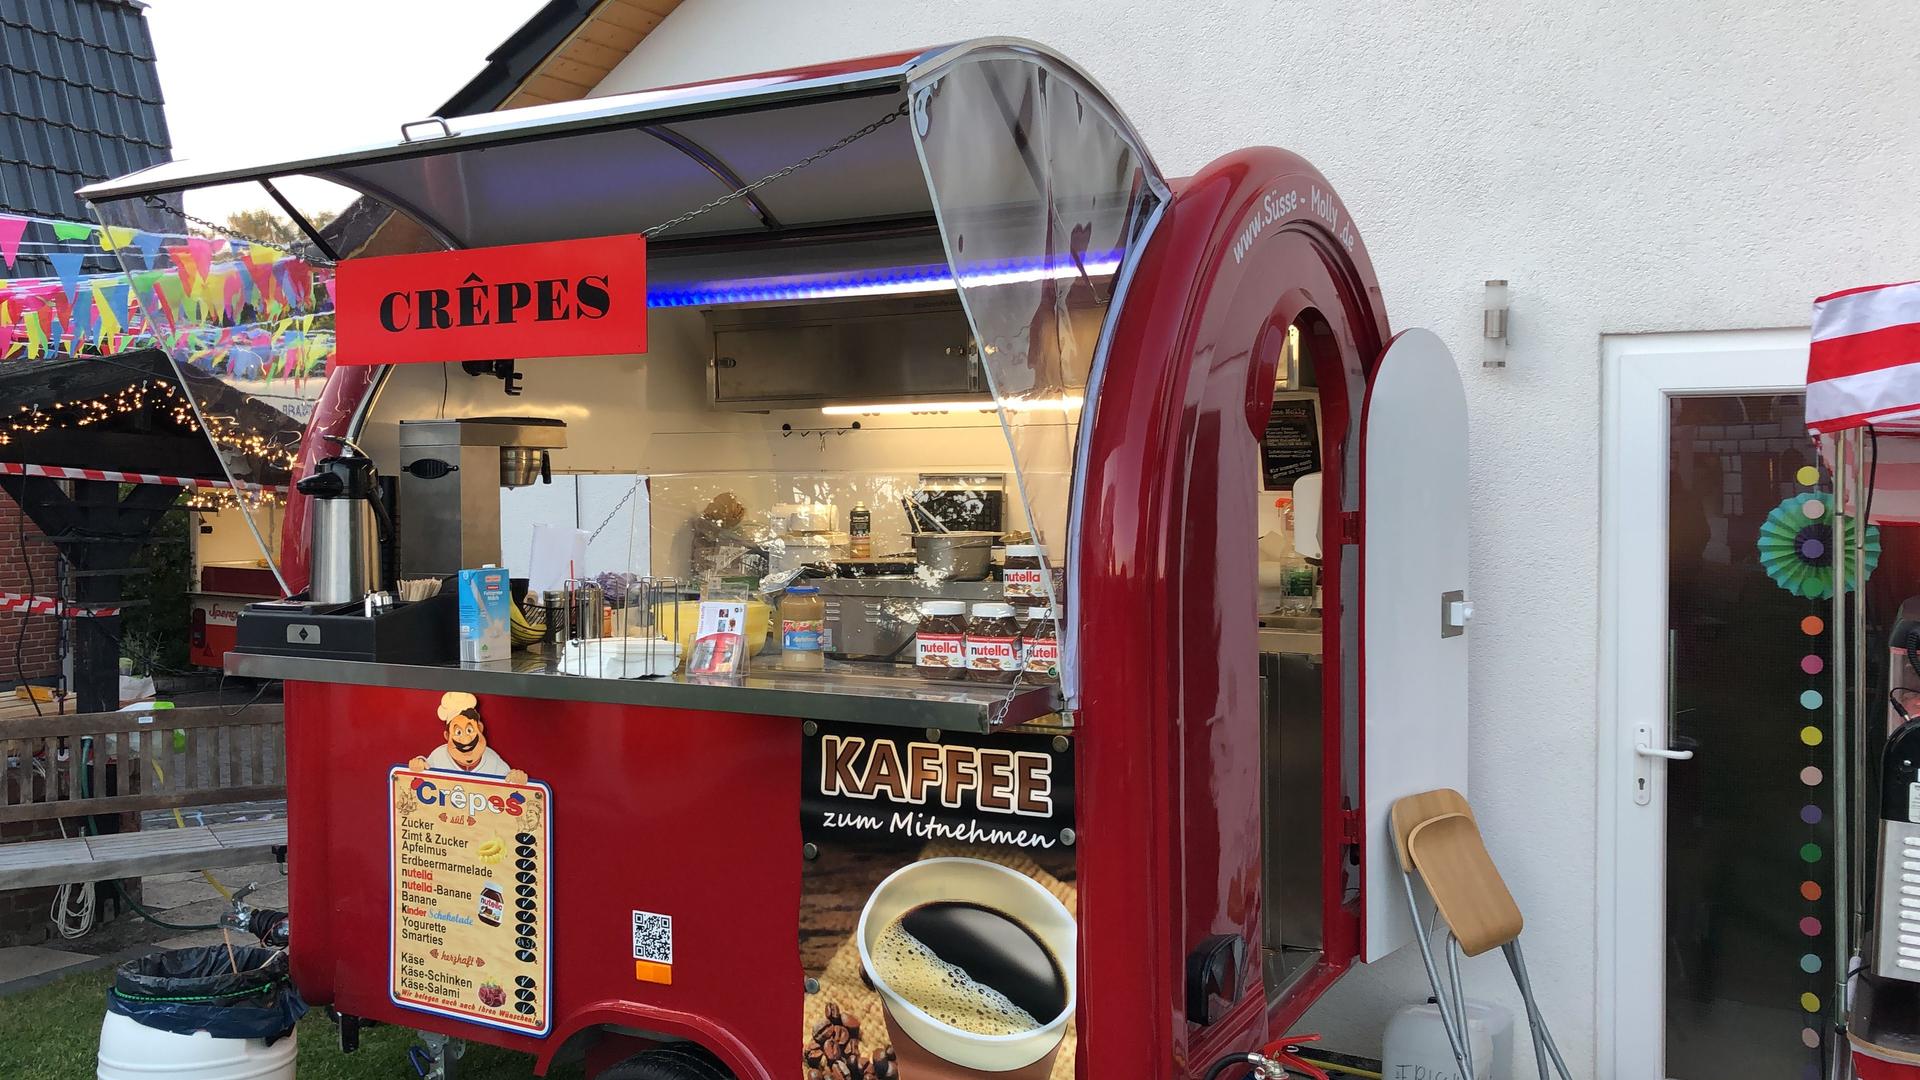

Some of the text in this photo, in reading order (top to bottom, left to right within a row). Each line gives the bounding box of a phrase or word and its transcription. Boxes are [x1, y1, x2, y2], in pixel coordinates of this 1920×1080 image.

[1233, 190, 1297, 264] www.Süsse
[1311, 185, 1338, 232] Molly
[1340, 221, 1354, 252] .de
[379, 272, 611, 332] CRÊPES
[1005, 571, 1041, 583] nutella
[920, 642, 958, 654] nutella
[971, 645, 1010, 657] nutella
[821, 735, 1053, 818] KAFFEE
[416, 781, 523, 816] Crêpes
[401, 816, 434, 831] Zucker
[823, 810, 1056, 849] zum Mitnehmen
[401, 829, 469, 849] Zimt & Zucker
[401, 841, 447, 857] Apfelmus
[401, 854, 493, 878] Erdbeermarmelade
[401, 868, 433, 881] nutella
[401, 893, 437, 907] Banane
[480, 896, 503, 911] nutella
[401, 903, 474, 926] kinder Schokolade
[402, 916, 447, 934] Yogurette
[402, 929, 444, 946] Smarties
[401, 952, 425, 966] Käse
[441, 950, 474, 968] herzhaft
[401, 965, 473, 989] Käse-Schinken
[401, 977, 460, 999] Käse-Salami
[401, 988, 413, 998] Wir
[415, 991, 439, 1004] belegen
[478, 1003, 497, 1016] Ihren
[499, 1009, 537, 1025] Wünschen!
